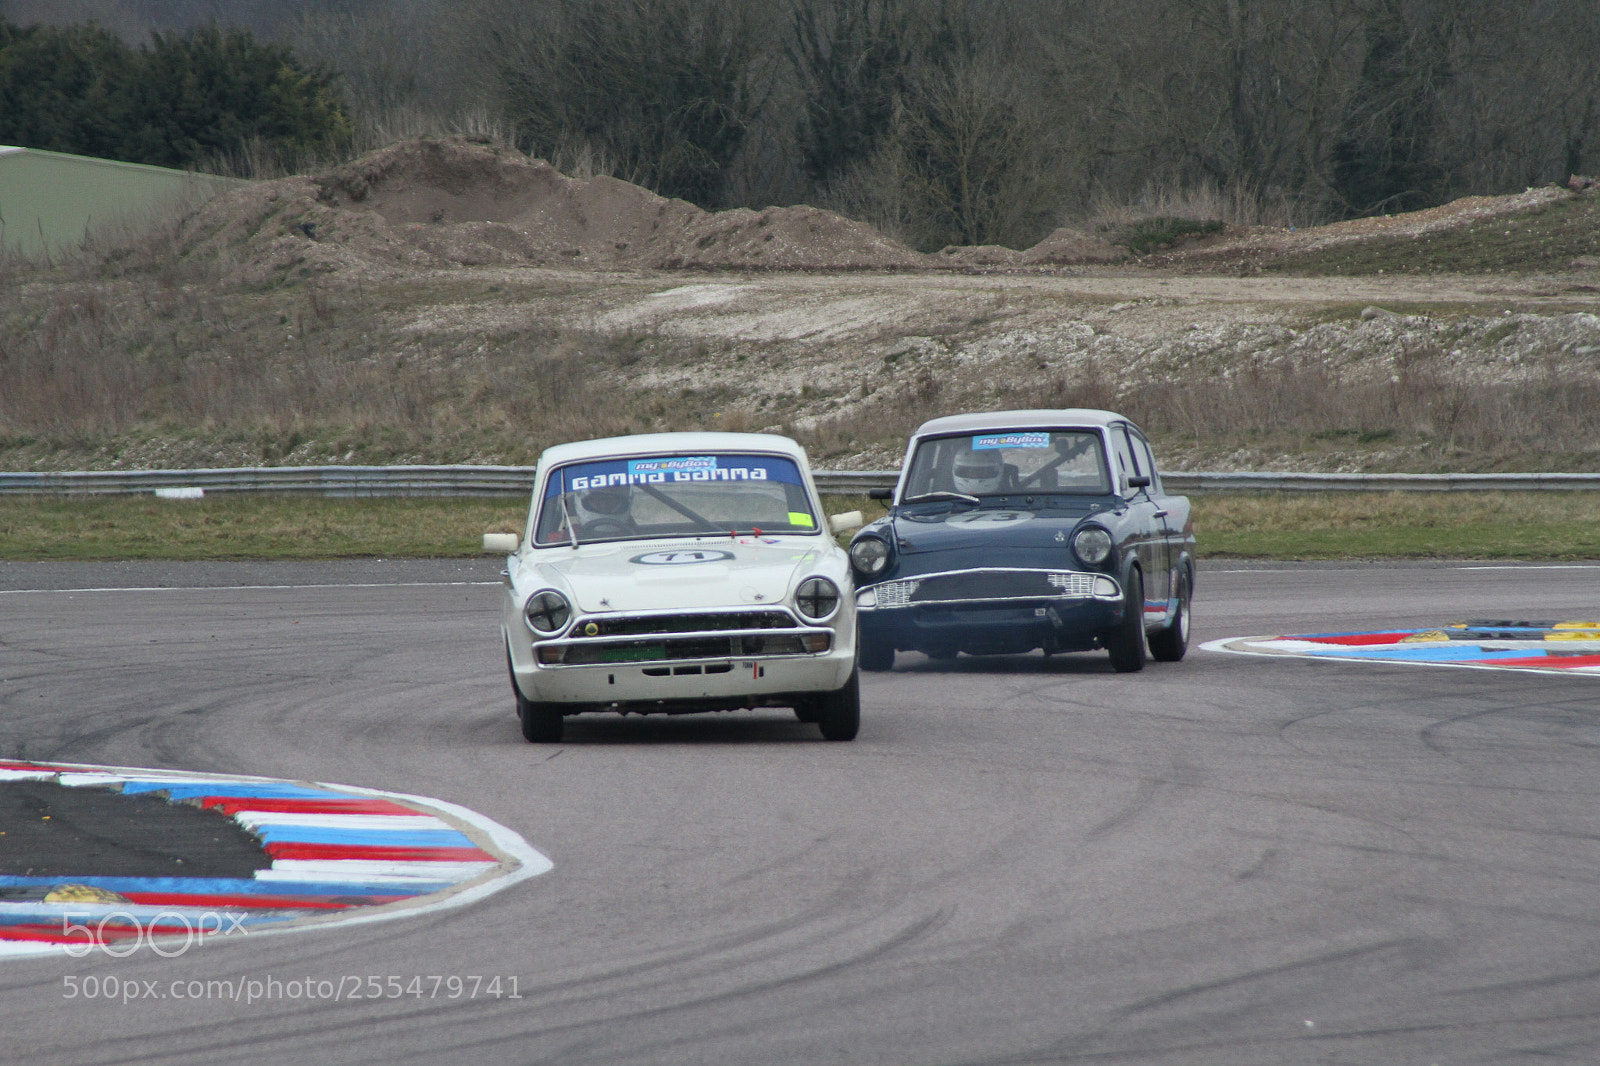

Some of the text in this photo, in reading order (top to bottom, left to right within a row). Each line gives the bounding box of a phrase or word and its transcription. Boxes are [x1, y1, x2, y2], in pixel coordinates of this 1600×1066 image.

[635, 462, 659, 471] my
[962, 512, 1020, 523] 73
[658, 552, 704, 561] 71
